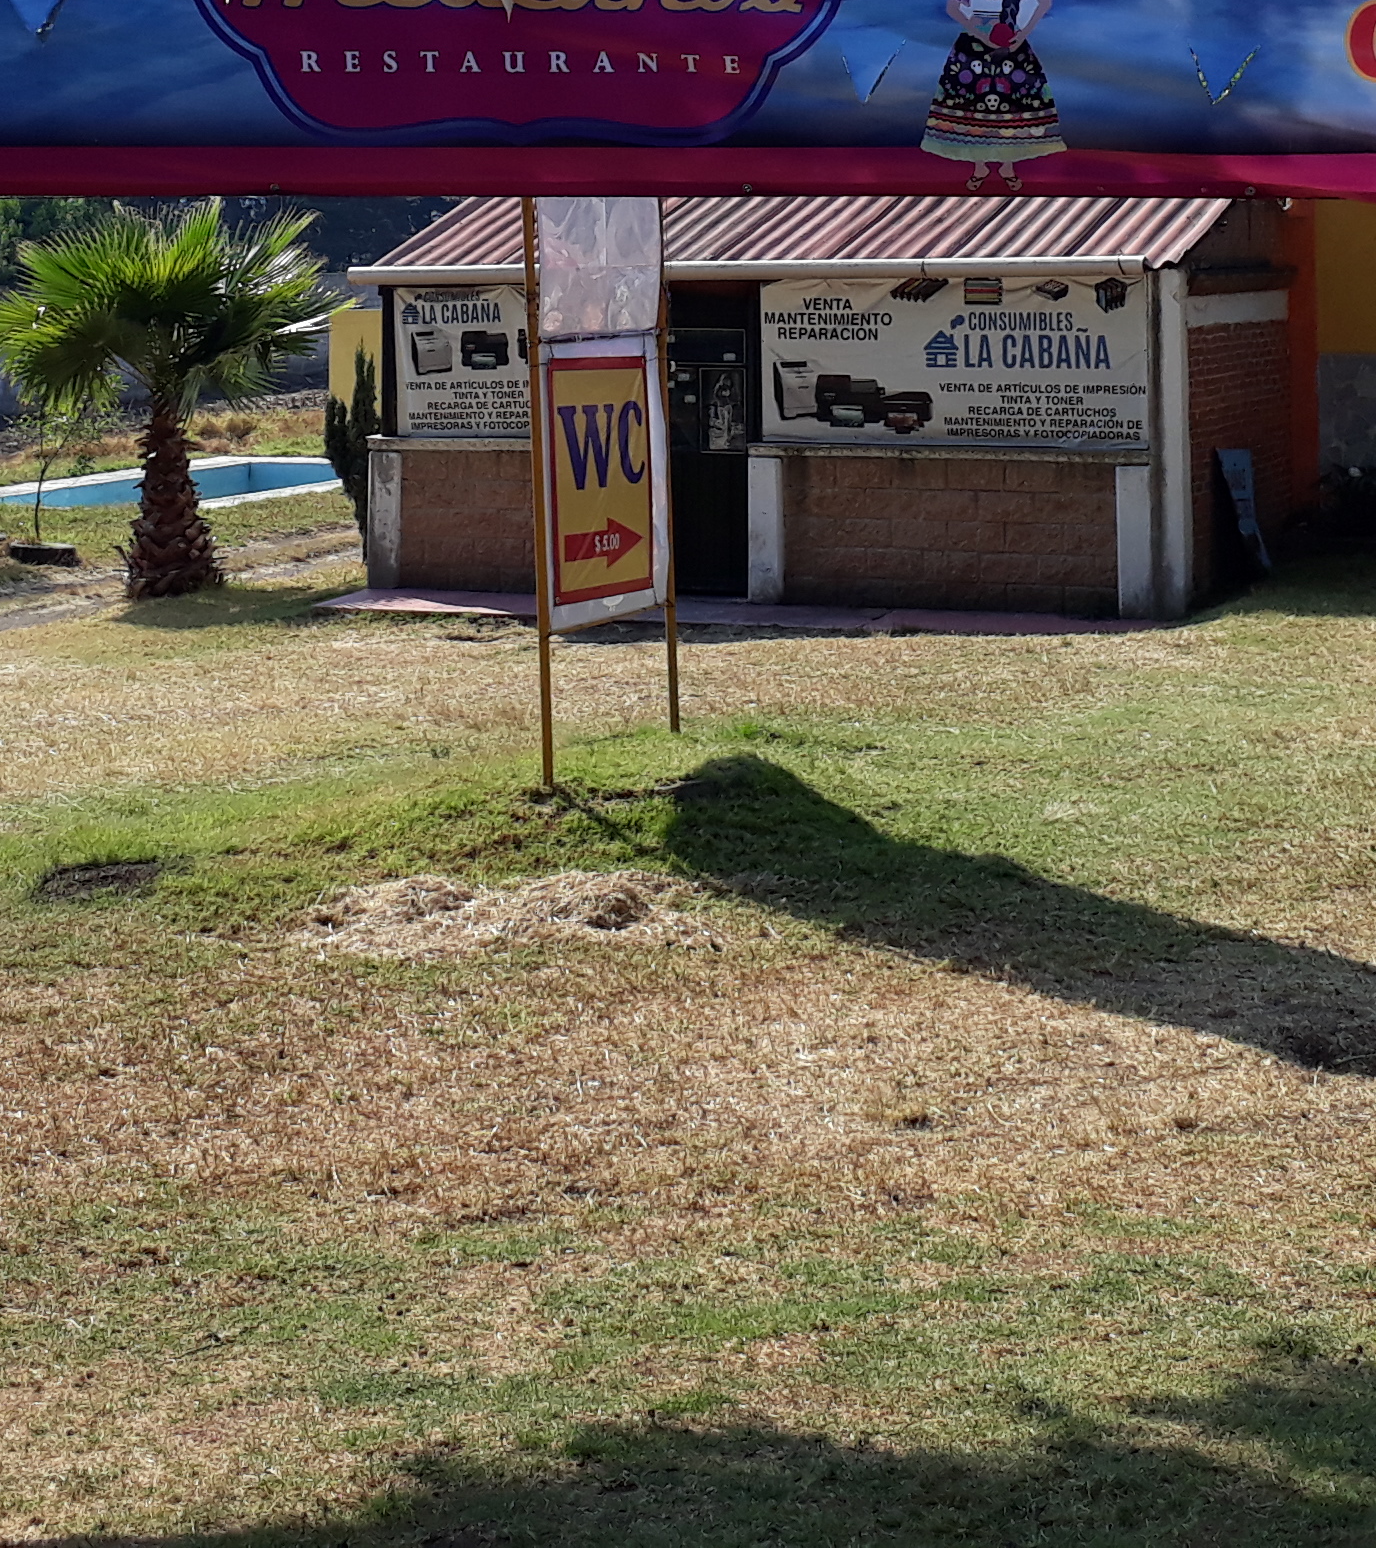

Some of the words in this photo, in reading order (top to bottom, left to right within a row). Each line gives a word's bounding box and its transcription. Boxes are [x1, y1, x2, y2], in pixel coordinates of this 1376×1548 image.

[300, 49, 741, 75] RESTAURANTE
[421, 304, 438, 324] LA
[441, 298, 501, 324] CABAÑA
[802, 297, 853, 311] VENTA
[764, 311, 893, 327] MANTENIMIENTO
[968, 311, 1074, 332] CONSUMIBLES
[964, 334, 994, 369] LA
[1002, 327, 1111, 370] CABAÑA
[435, 381, 447, 390] DE
[507, 380, 521, 389] DE
[938, 382, 975, 393] VENTA
[978, 383, 993, 393] DE
[995, 381, 1061, 394] ARTÍCULOS
[1064, 384, 1080, 394] DE
[1082, 382, 1147, 395] IMPRESIÓN
[482, 391, 489, 400] Y
[491, 390, 524, 400] TONER
[1000, 395, 1032, 405] TINTA
[1035, 395, 1042, 405] Y
[1045, 395, 1084, 406] TONER
[427, 401, 474, 411] RECARGA
[476, 401, 489, 410] DE
[491, 400, 531, 410] CARTUC
[968, 405, 1024, 416] RECARGA
[1026, 406, 1043, 417] DE
[1045, 407, 1117, 418] CARTUCHOS
[487, 411, 493, 420] Y
[495, 411, 530, 420] REPAR
[475, 421, 481, 430] Y
[483, 420, 530, 430] FOTOCOP
[944, 416, 1037, 428] MANTENIMIENTO
[1039, 418, 1046, 428] Y
[1127, 419, 1143, 430] DE
[1024, 429, 1031, 438] Y
[1034, 429, 1141, 441] FOTOCOPIADORAS
[557, 400, 646, 491] WC
